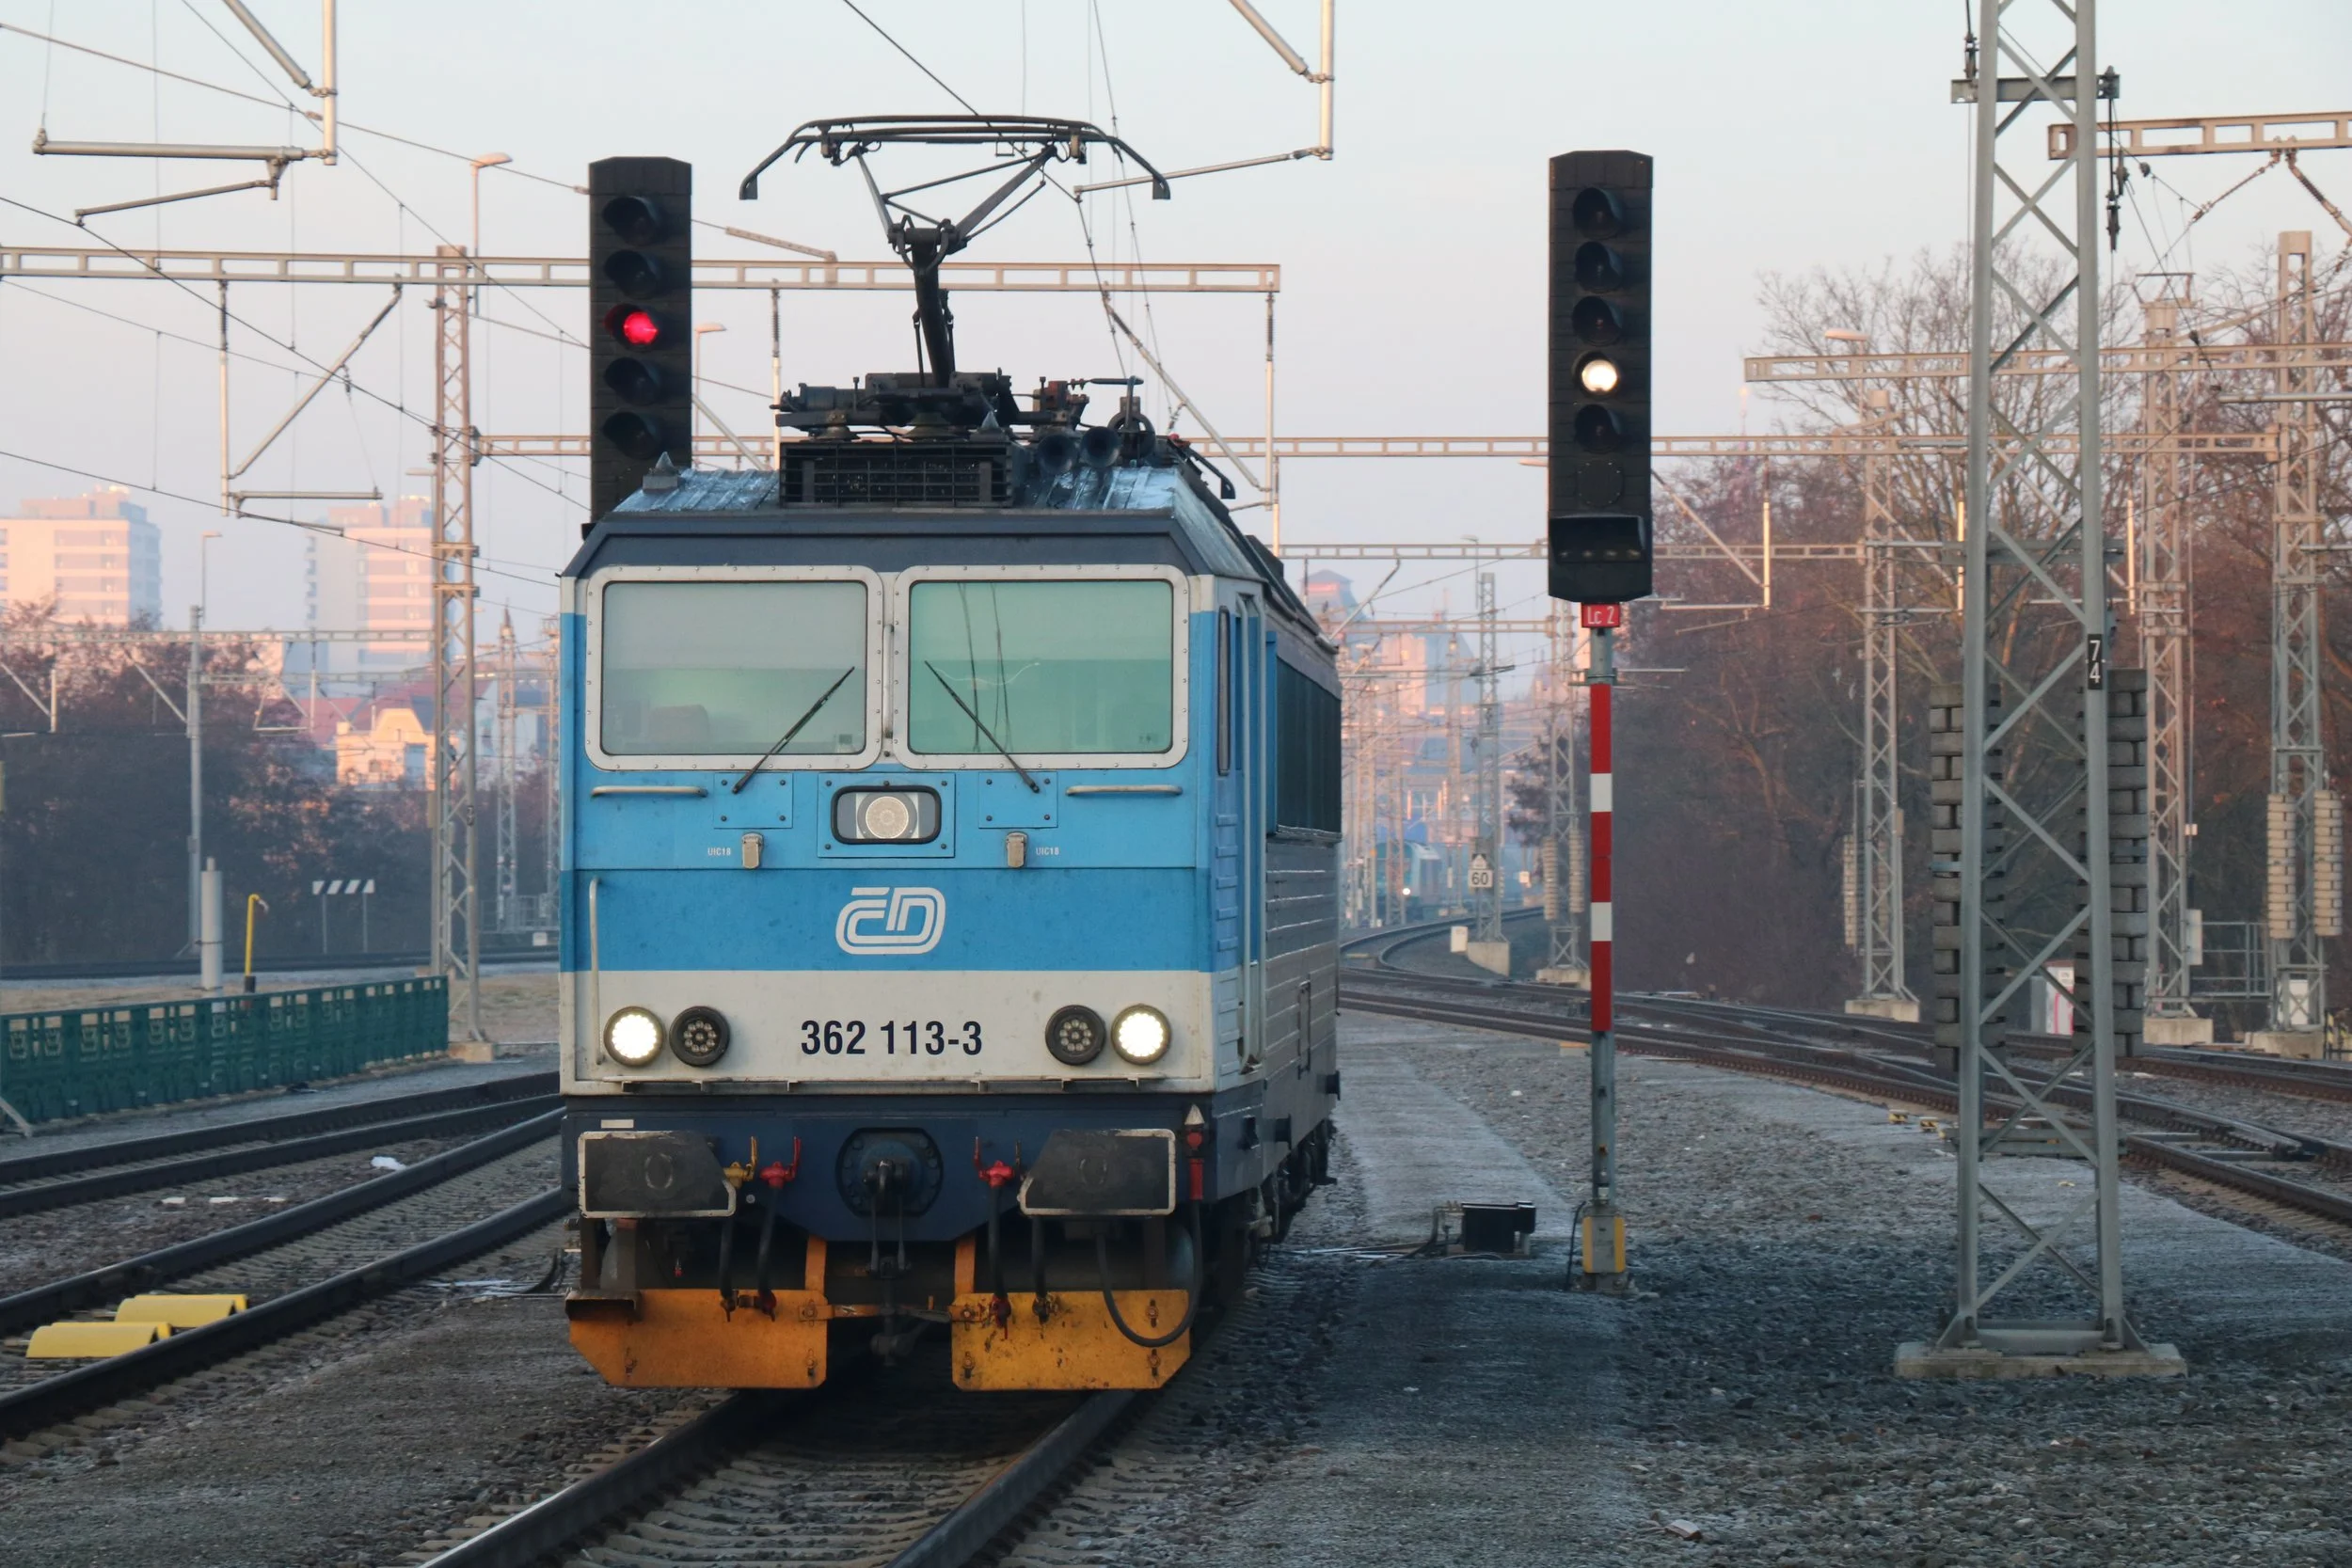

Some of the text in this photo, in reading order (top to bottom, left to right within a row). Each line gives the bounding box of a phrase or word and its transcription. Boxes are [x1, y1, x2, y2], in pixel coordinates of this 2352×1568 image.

[1587, 606, 1614, 625] Lc 2
[707, 847, 731, 856] UIC18
[1472, 872, 1488, 885] 60
[835, 887, 946, 955] ČD
[801, 1020, 982, 1055] 362 113-3
